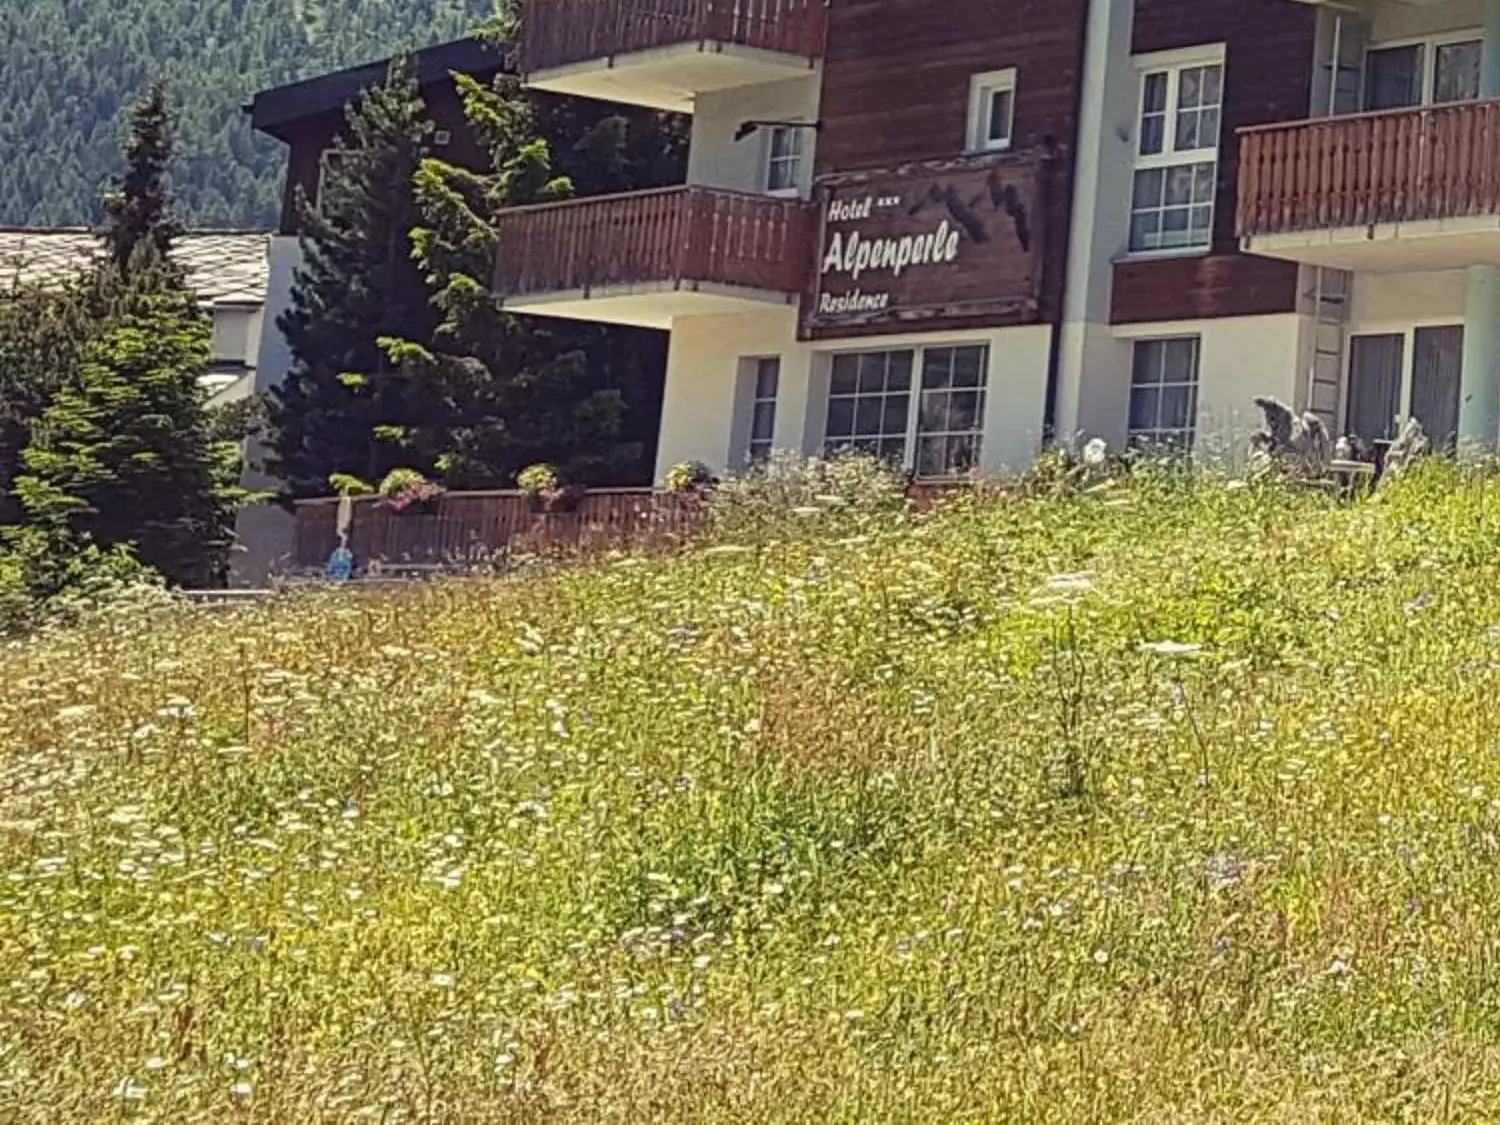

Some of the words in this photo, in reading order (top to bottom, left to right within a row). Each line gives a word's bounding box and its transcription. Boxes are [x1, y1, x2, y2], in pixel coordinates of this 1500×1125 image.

[827, 195, 873, 222] Hotel
[821, 219, 959, 280] Alpenperle
[819, 288, 889, 313] Residence
